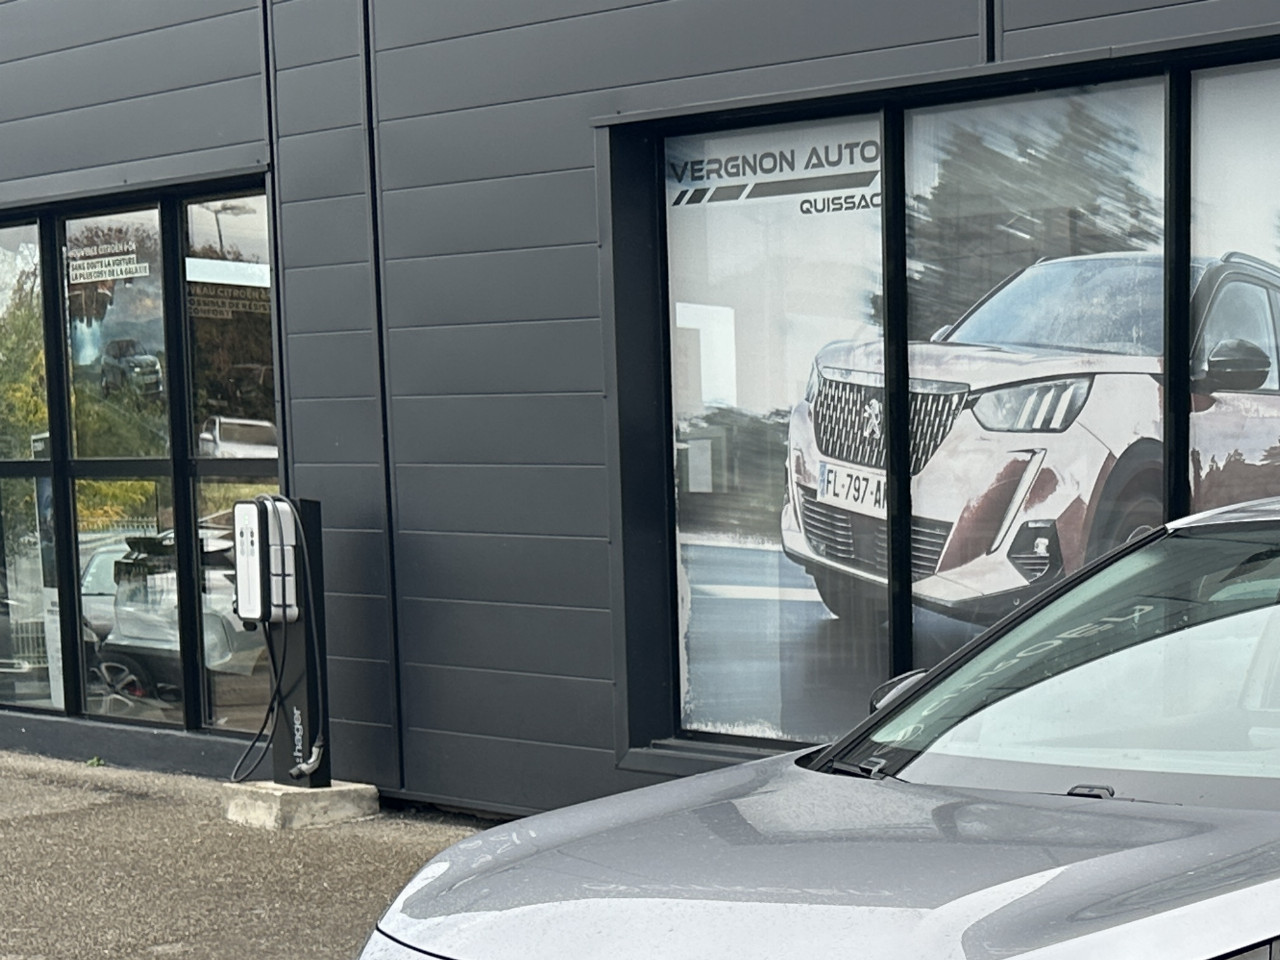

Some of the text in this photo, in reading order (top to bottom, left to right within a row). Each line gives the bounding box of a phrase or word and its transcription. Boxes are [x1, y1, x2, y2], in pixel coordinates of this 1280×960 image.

[669, 140, 881, 183] VERGNON AUTO
[800, 192, 882, 215] QUISSAC
